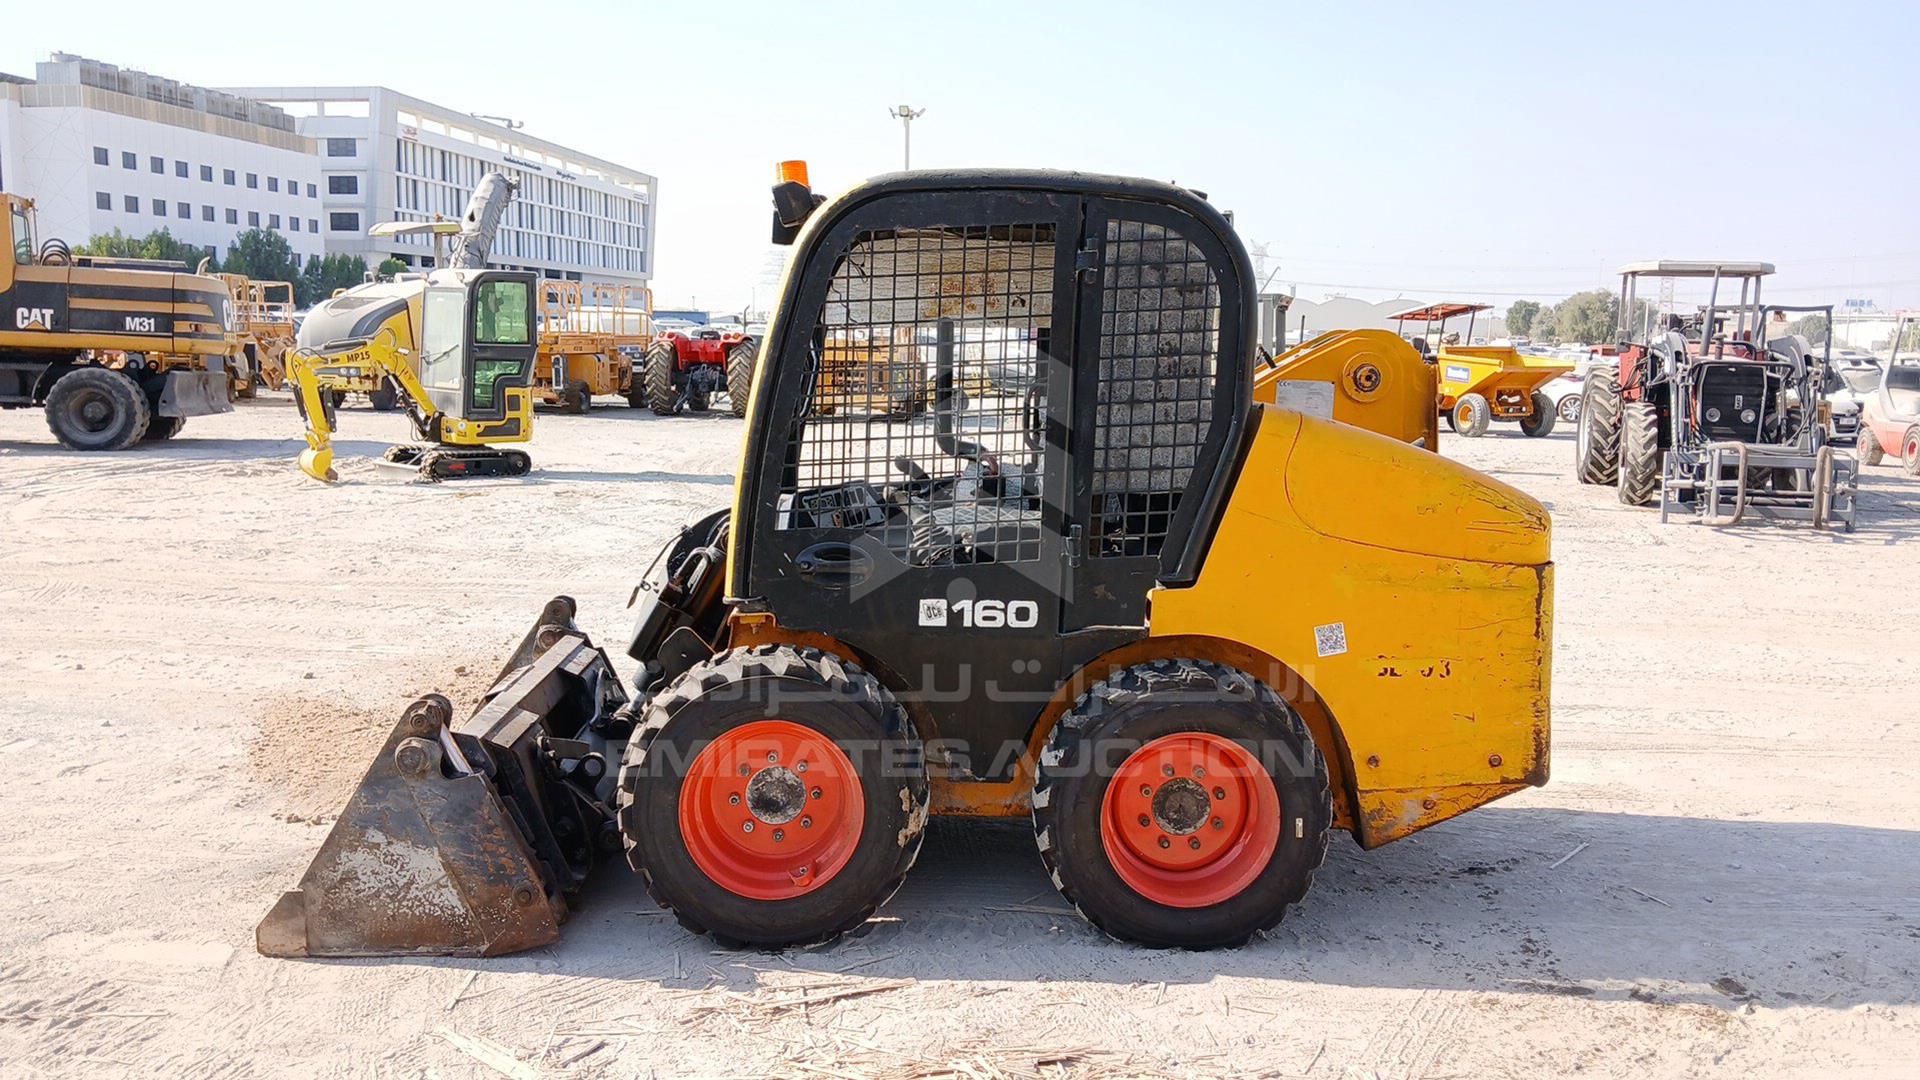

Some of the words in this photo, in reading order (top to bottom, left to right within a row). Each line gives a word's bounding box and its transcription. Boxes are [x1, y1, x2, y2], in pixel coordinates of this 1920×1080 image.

[16, 307, 54, 330] CAT
[125, 316, 155, 332] M31
[346, 351, 371, 363] MP15
[952, 600, 1038, 628] 160
